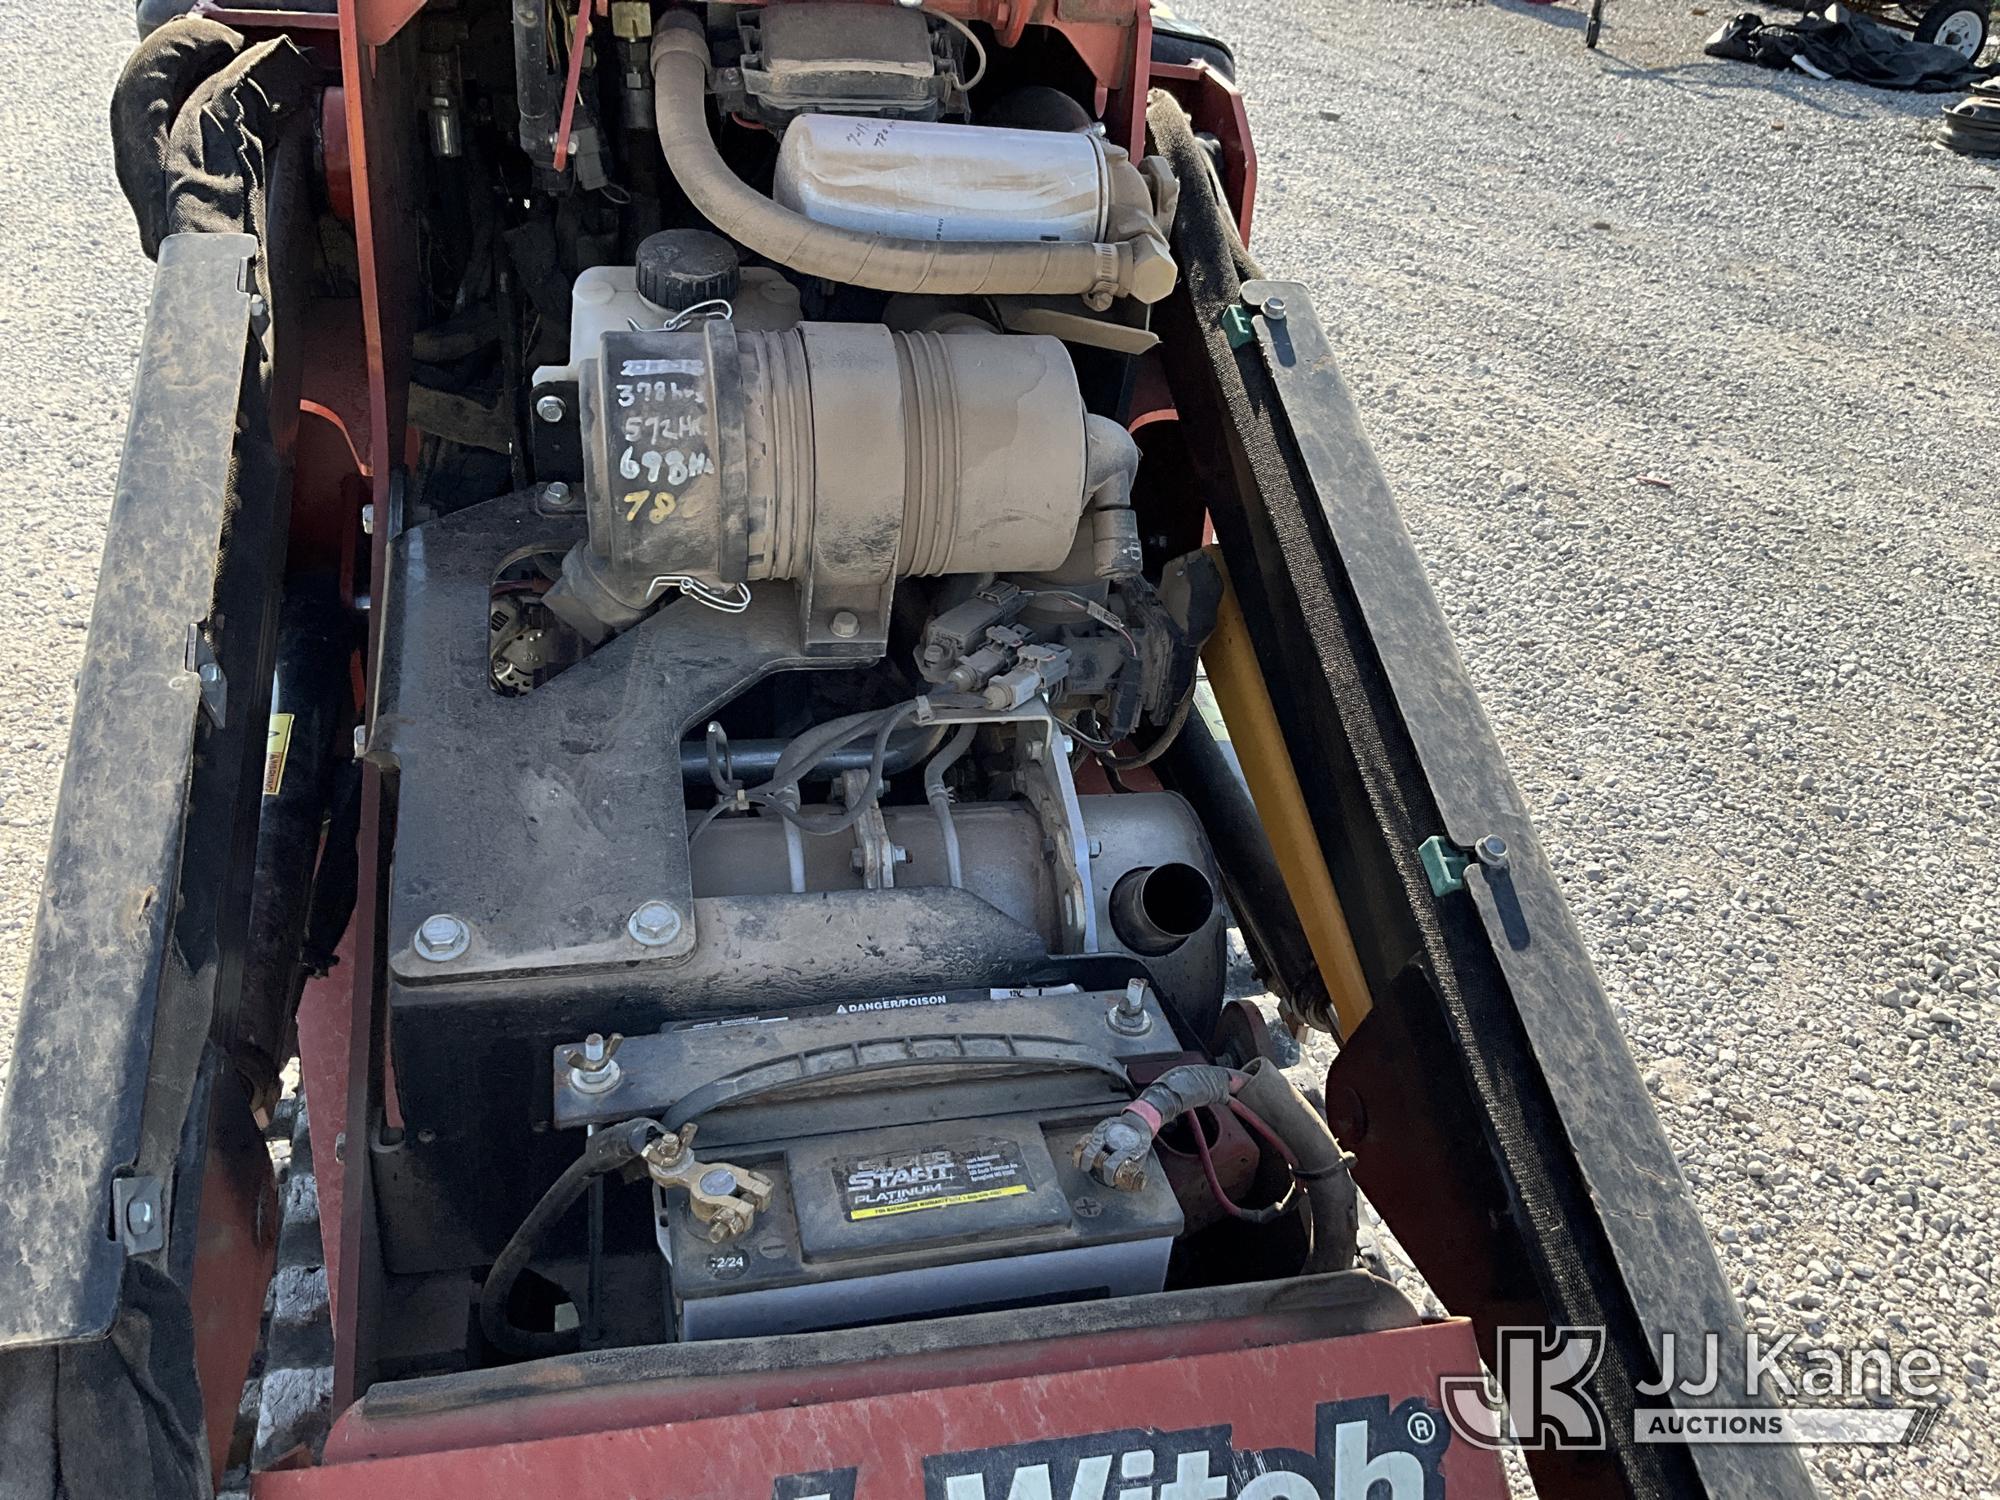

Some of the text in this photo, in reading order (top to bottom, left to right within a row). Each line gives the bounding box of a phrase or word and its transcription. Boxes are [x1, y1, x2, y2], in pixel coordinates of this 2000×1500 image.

[848, 995, 947, 1012] DANGER/POISON
[847, 1162, 955, 1192] START
[854, 1183, 942, 1205] PLATINUM
